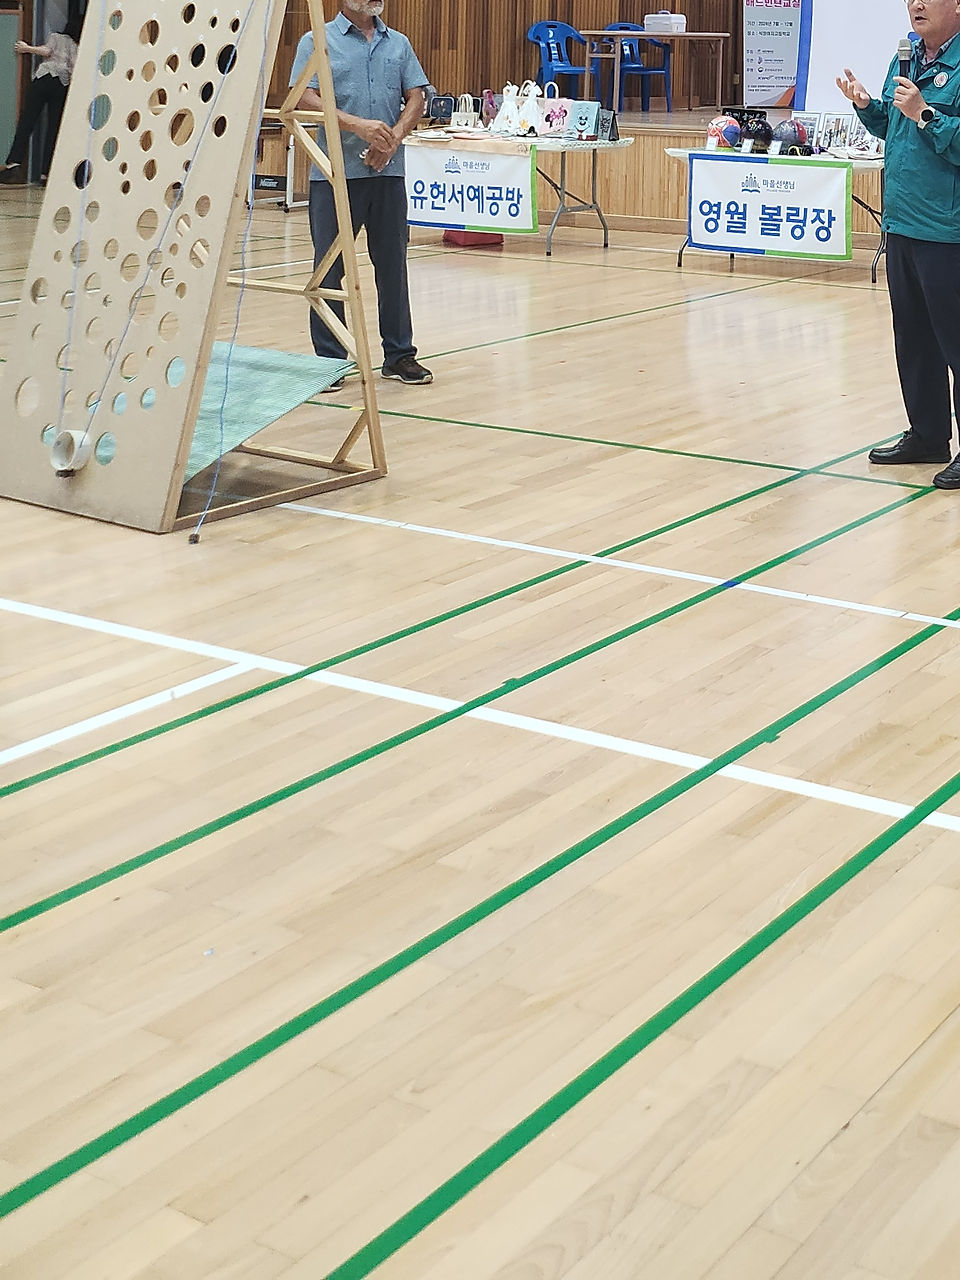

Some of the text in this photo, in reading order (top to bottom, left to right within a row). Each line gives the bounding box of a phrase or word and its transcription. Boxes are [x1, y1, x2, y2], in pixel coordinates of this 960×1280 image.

[462, 161, 490, 171] 마을선생님
[762, 179, 795, 190] 마을선생님
[410, 180, 523, 217] 유헌서예공방
[699, 200, 836, 242] 영월 볼링장
